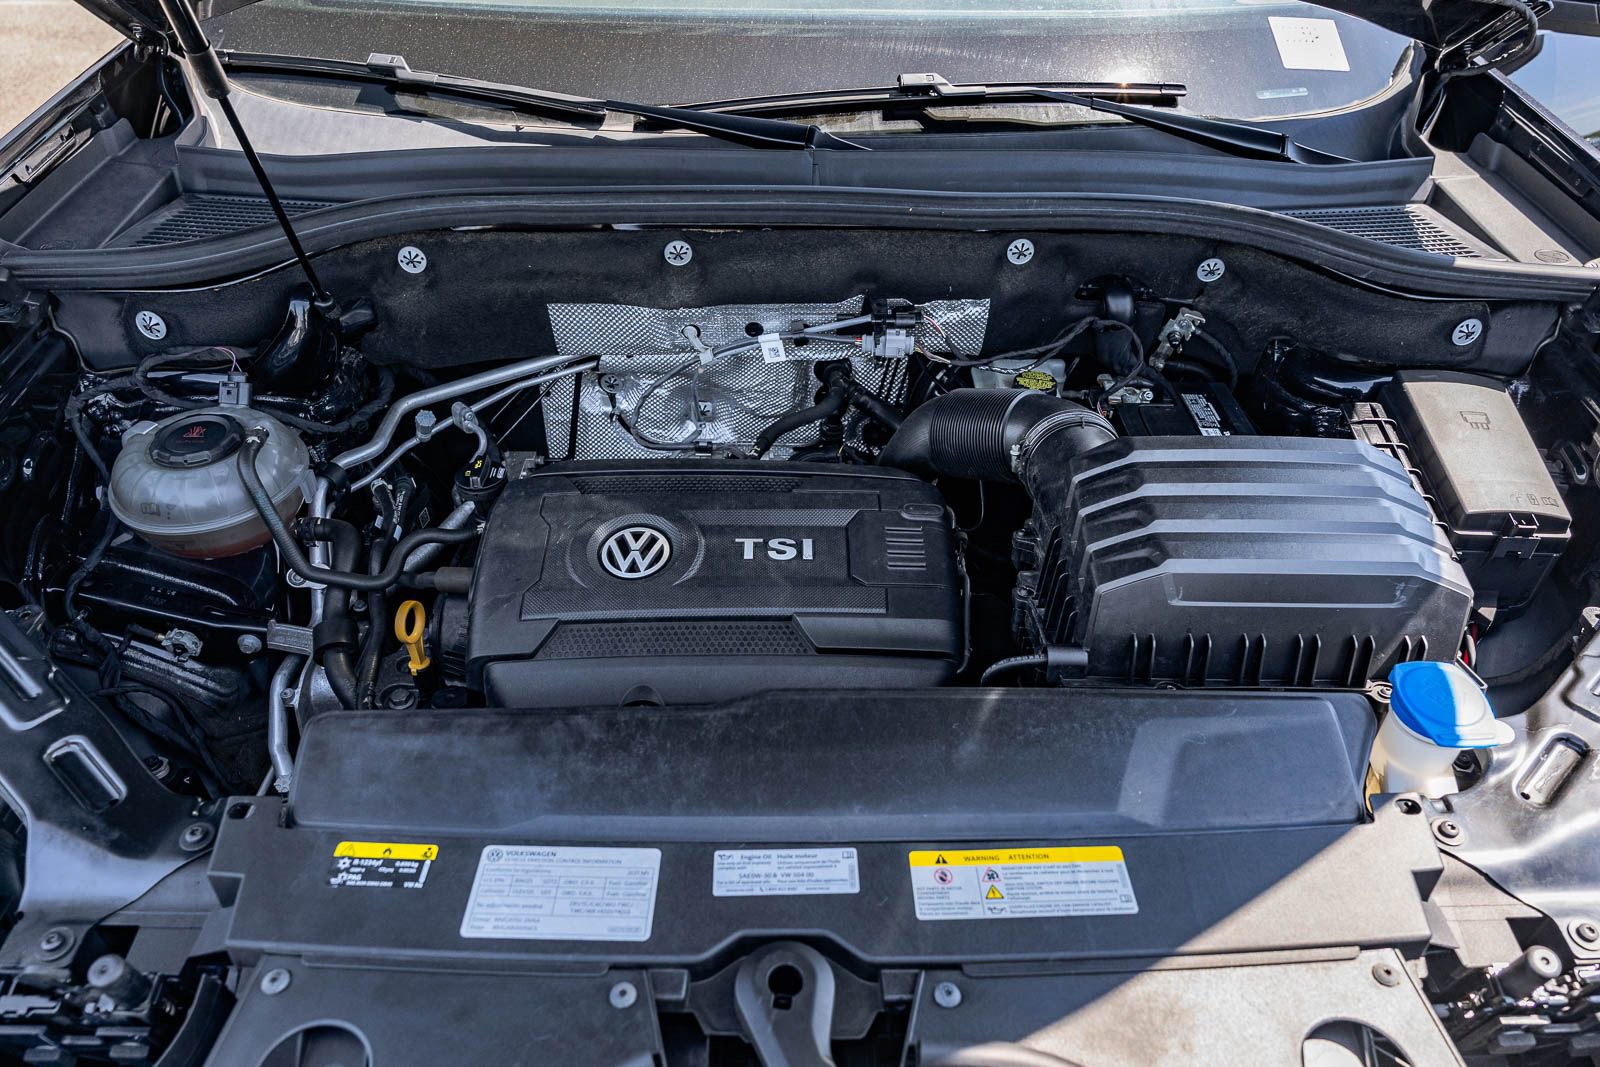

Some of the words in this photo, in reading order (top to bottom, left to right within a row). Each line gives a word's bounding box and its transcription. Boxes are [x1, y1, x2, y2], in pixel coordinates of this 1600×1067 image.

[601, 526, 671, 579] VW
[735, 538, 814, 560] TSI
[505, 849, 557, 857] VOLKSWAGEN
[1008, 853, 1050, 861] ATTENTION
